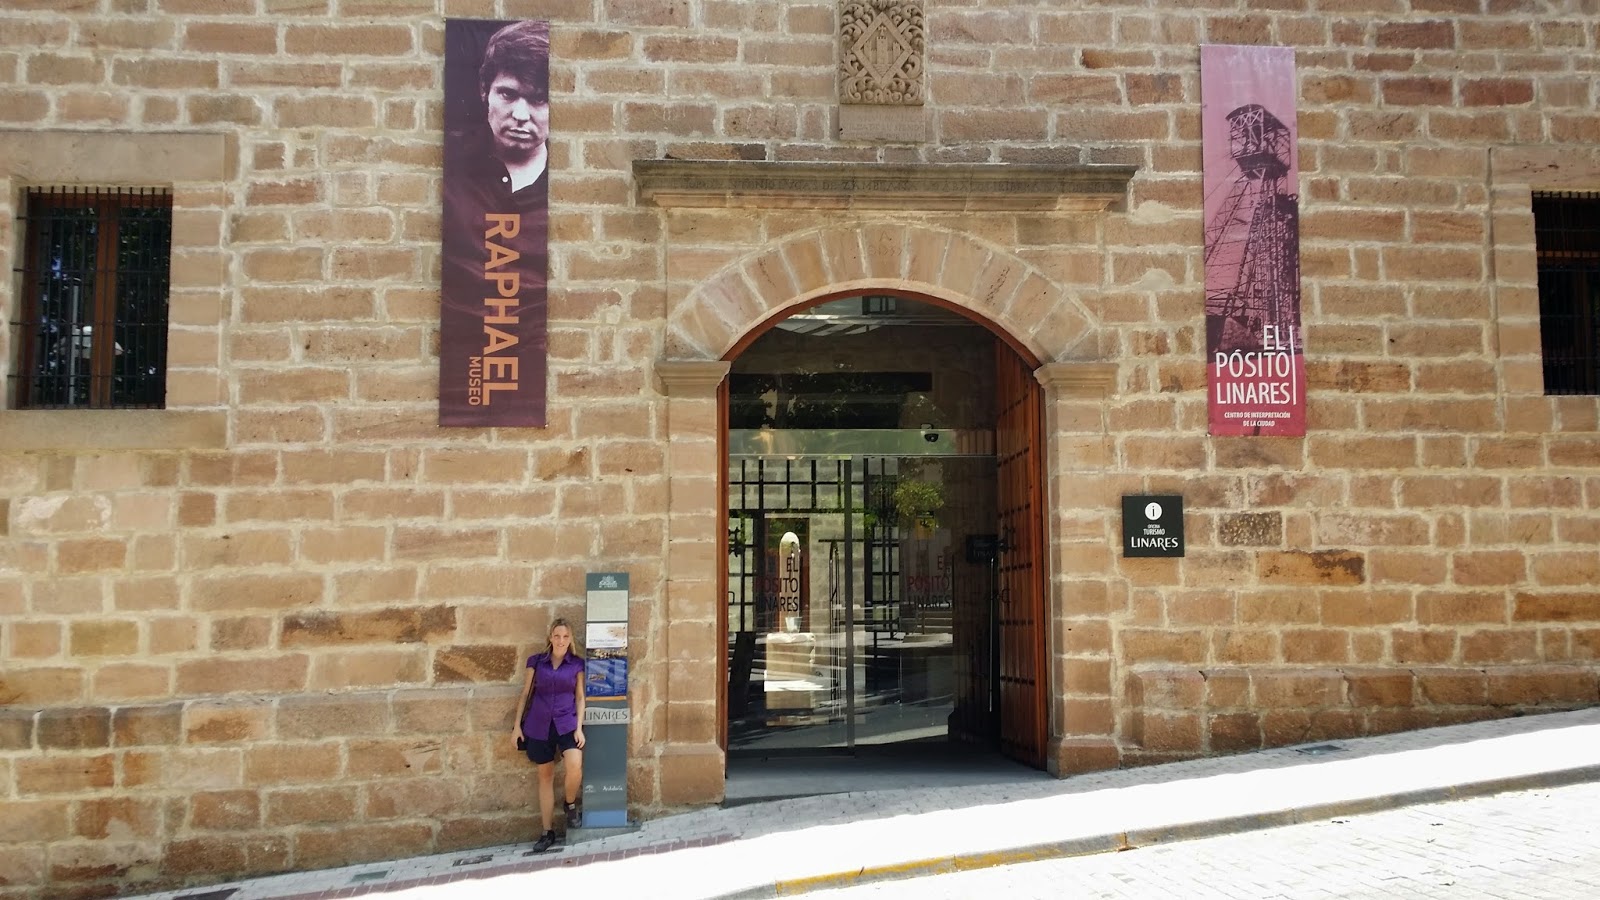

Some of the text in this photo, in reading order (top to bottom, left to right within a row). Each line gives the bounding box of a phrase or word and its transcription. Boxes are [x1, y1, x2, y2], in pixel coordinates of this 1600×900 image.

[483, 213, 521, 406] RAPHAEL
[1263, 325, 1286, 350] EL
[1215, 349, 1290, 377] PÓSITO
[468, 356, 482, 406] MUSEO
[1216, 382, 1291, 405] LINARES
[1224, 411, 1243, 419] CENTRO
[1251, 411, 1291, 419] INTERPRETACIÓN
[1131, 536, 1179, 551] LINARES
